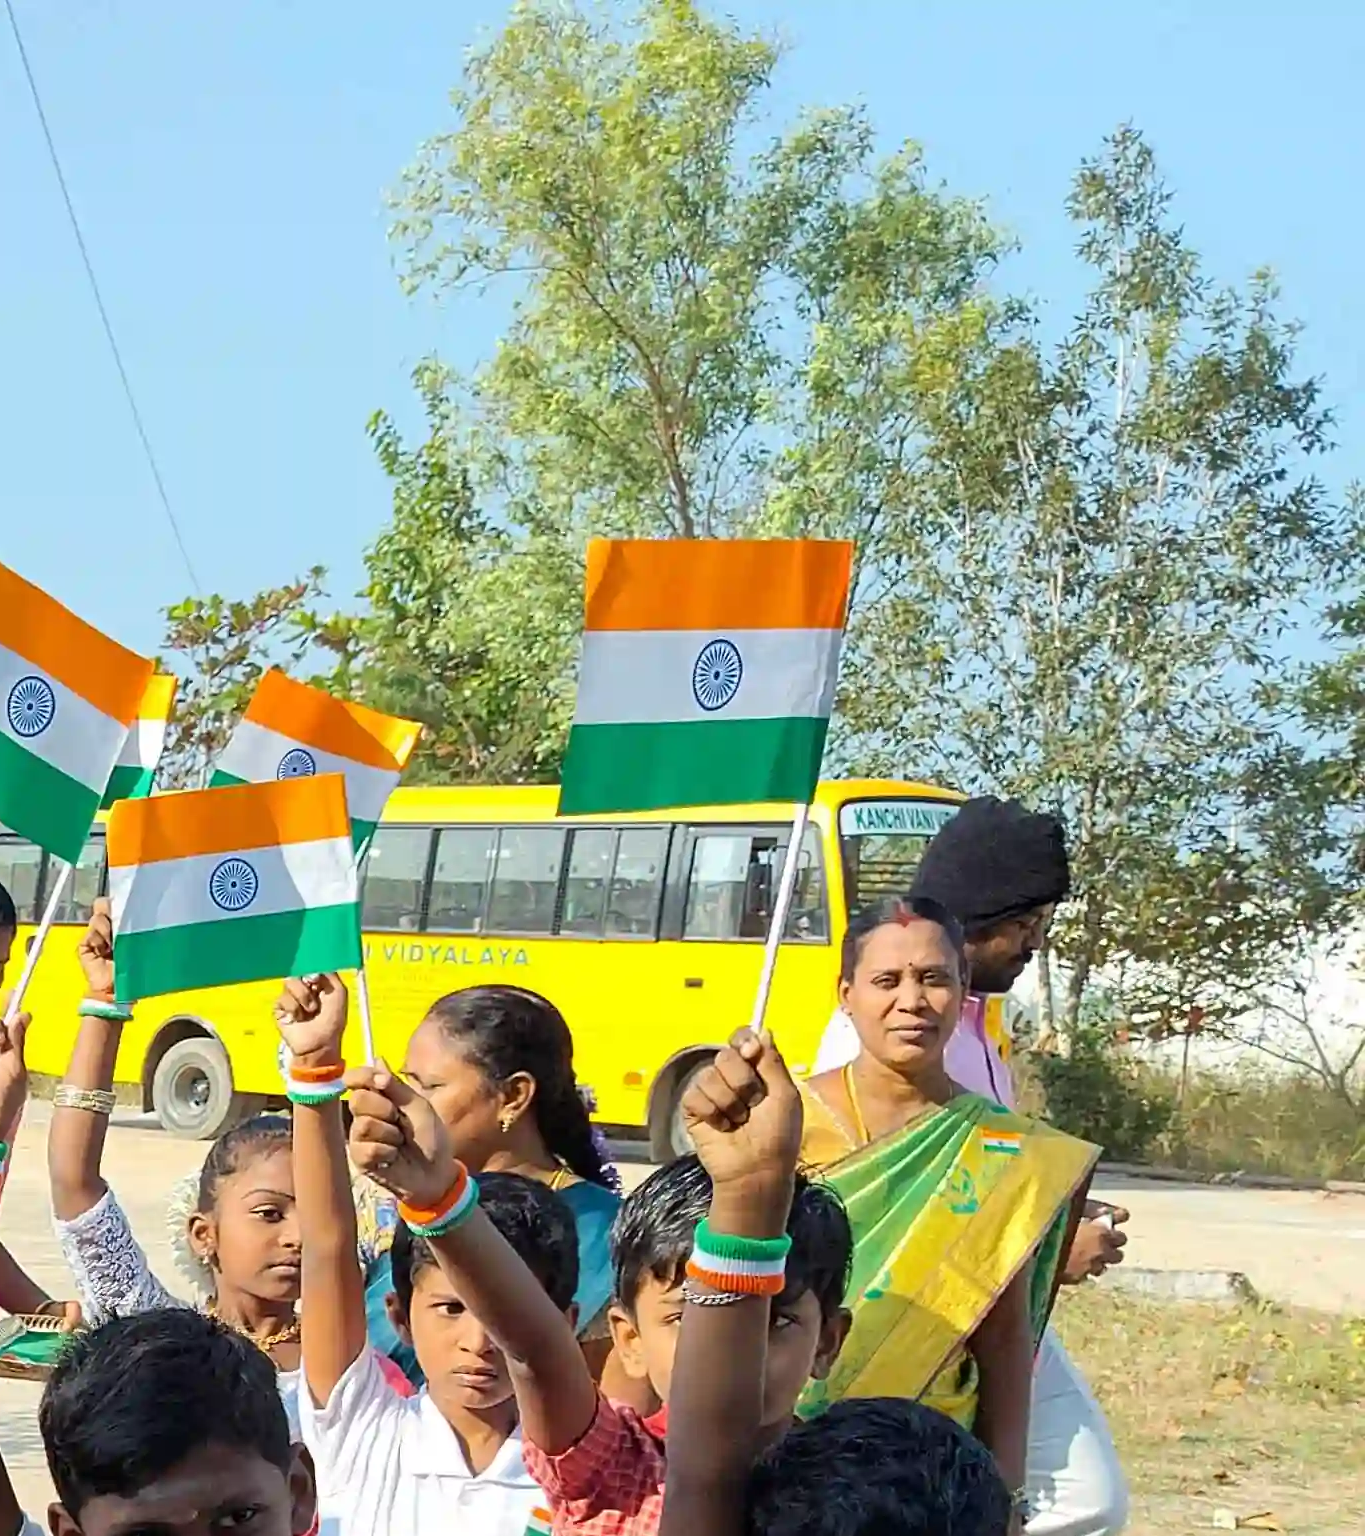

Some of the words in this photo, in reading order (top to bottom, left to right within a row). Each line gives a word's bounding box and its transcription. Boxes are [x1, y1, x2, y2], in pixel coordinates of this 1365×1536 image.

[854, 807, 905, 829] KANCHI
[906, 808, 936, 830] VANI
[383, 943, 530, 966] VIDYALAYA
